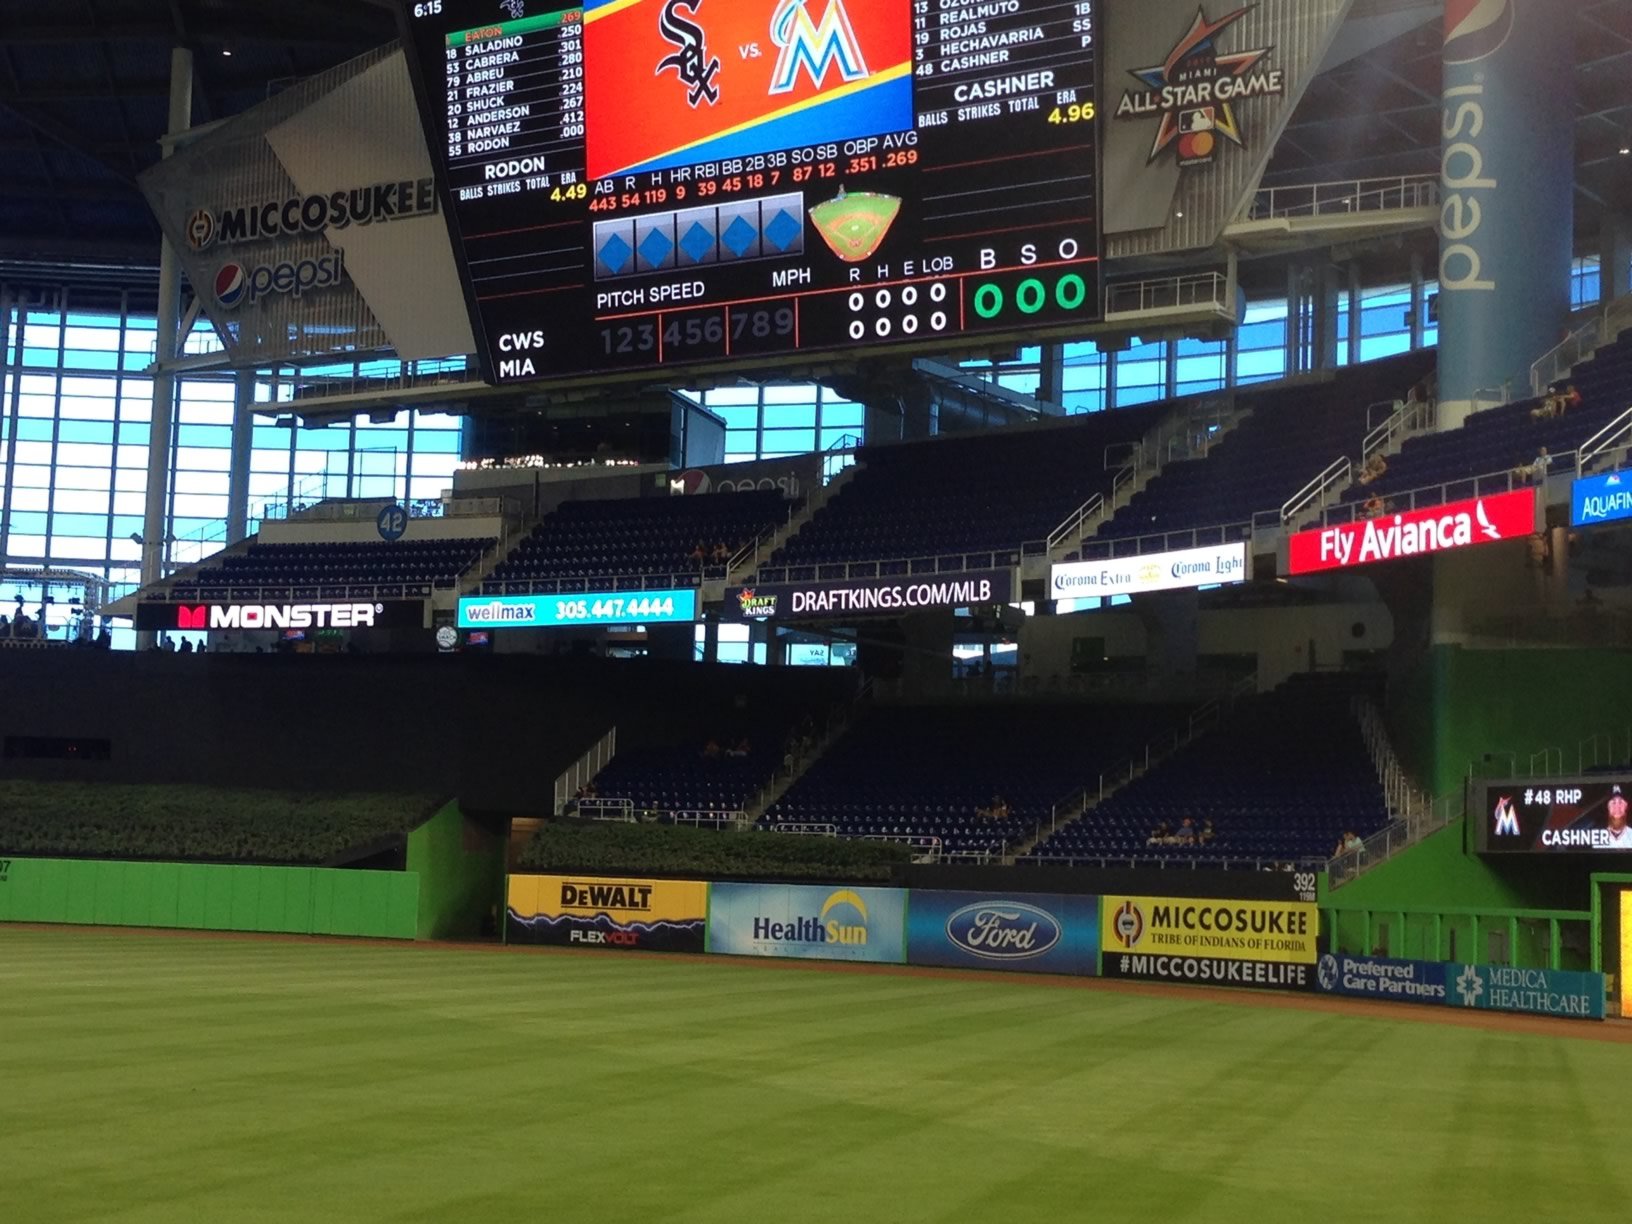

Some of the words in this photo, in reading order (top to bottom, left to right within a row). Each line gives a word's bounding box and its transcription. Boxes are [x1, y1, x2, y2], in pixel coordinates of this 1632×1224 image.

[414, 1, 442, 17] 6:15
[914, 1, 928, 14] 13
[915, 17, 926, 29] 11
[940, 1, 1019, 25] REALMUTO
[465, 27, 502, 42] EATON
[915, 32, 930, 45] 19
[940, 22, 987, 41] ROJAS
[1074, 3, 1091, 16] 1B
[446, 49, 457, 60] 18
[465, 36, 523, 56] SALADINO
[916, 49, 924, 61] 3
[940, 27, 1044, 56] HECHAVARRIA
[1073, 19, 1091, 32] SS
[447, 63, 460, 74] 53
[465, 51, 519, 70] CABRERA
[916, 63, 934, 76] 48
[940, 50, 1009, 73] CASHNER
[1081, 35, 1091, 48] P
[447, 77, 460, 88] 79
[466, 68, 504, 85] ABREU
[954, 71, 1055, 102] CASHNER
[1179, 67, 1217, 82] MIAMI
[1214, 71, 1282, 99] GAME
[447, 91, 458, 101] 21
[467, 80, 514, 98] FRAZIER
[447, 105, 462, 116] 20
[467, 96, 504, 112] SHUCK
[447, 118, 459, 129] 12
[467, 105, 530, 126] ANDERSON
[918, 112, 948, 128] BALLS
[958, 103, 1001, 121] STRIKES
[1008, 97, 1040, 113] TOTAL
[1057, 90, 1077, 105] ERA
[1047, 102, 1095, 124] 4.96
[448, 132, 462, 143] 38
[467, 121, 521, 141] NARVAEZ
[448, 145, 462, 157] 55
[468, 137, 510, 154] RODON
[560, 124, 584, 138] .000
[485, 156, 545, 180] RODON
[594, 179, 614, 195] AB
[625, 176, 636, 191] R
[651, 172, 662, 186] H
[671, 167, 691, 183] HR
[695, 162, 719, 179] RBI
[722, 159, 743, 175] BB
[745, 155, 765, 172] 2B
[767, 152, 787, 168] 3B
[791, 148, 814, 164] SO
[816, 144, 838, 160] SB
[844, 138, 878, 155] OBP
[883, 131, 918, 149] AVG
[459, 187, 484, 201] BALLS
[487, 181, 521, 196] STRIKES
[525, 176, 550, 191] TOTAL
[561, 172, 577, 186] ERA
[550, 183, 587, 202] 4.49
[589, 196, 617, 212] 443
[621, 192, 640, 207] 54
[644, 188, 667, 204] 119
[675, 185, 686, 200] 9
[698, 181, 717, 196] 39
[722, 177, 742, 193] 45
[746, 173, 764, 189] 18
[771, 171, 780, 186] 7
[793, 166, 813, 182] 87
[818, 162, 836, 178] 12
[845, 156, 876, 174] .351
[882, 150, 918, 168] .269
[1440, 84, 1496, 291] pepsi
[219, 177, 435, 242] MICCOSUKEE
[849, 268, 860, 282] R
[877, 264, 889, 278] H
[904, 261, 914, 275] E
[923, 256, 953, 273] LOB
[980, 248, 996, 270] B
[1021, 244, 1037, 265] S
[250, 249, 342, 302] pepsi
[597, 289, 644, 309] PITCH
[649, 281, 705, 302] SPEED
[772, 267, 811, 288] MPH
[499, 331, 544, 352] CWS
[499, 358, 535, 378] MIA
[381, 512, 402, 532] 42
[1321, 527, 1354, 565] Fly
[1359, 512, 1471, 562] Avianca
[1171, 561, 1210, 579] Corona
[1055, 574, 1097, 591] Corona
[742, 597, 776, 609] DRAFT
[792, 580, 991, 612] DRAFTKINGS.COM/MLB
[468, 602, 533, 621] wellmax
[556, 597, 674, 621] 305.447.4444
[746, 606, 775, 615] KINGS
[1524, 788, 1551, 805] #48
[1555, 788, 1582, 805] RHP
[1542, 829, 1610, 846] CASHNER
[1293, 873, 1315, 891] 392
[967, 910, 1035, 950] Ford
[1151, 905, 1307, 935] MICCOSUKEE
[1151, 933, 1182, 945] TRIBE
[1184, 934, 1198, 946] OF
[1200, 935, 1246, 949] INDIANS
[1249, 938, 1263, 949] OF
[1264, 939, 1306, 952] FLORIDA
[1120, 955, 1306, 985] #MICCOSUKEELIFE
[1343, 959, 1414, 979] Preferred
[1490, 968, 1547, 989] MEDICA
[1343, 974, 1376, 991] Care
[1379, 977, 1446, 997] Partners
[1490, 989, 1590, 1015] HEALTHCARE
